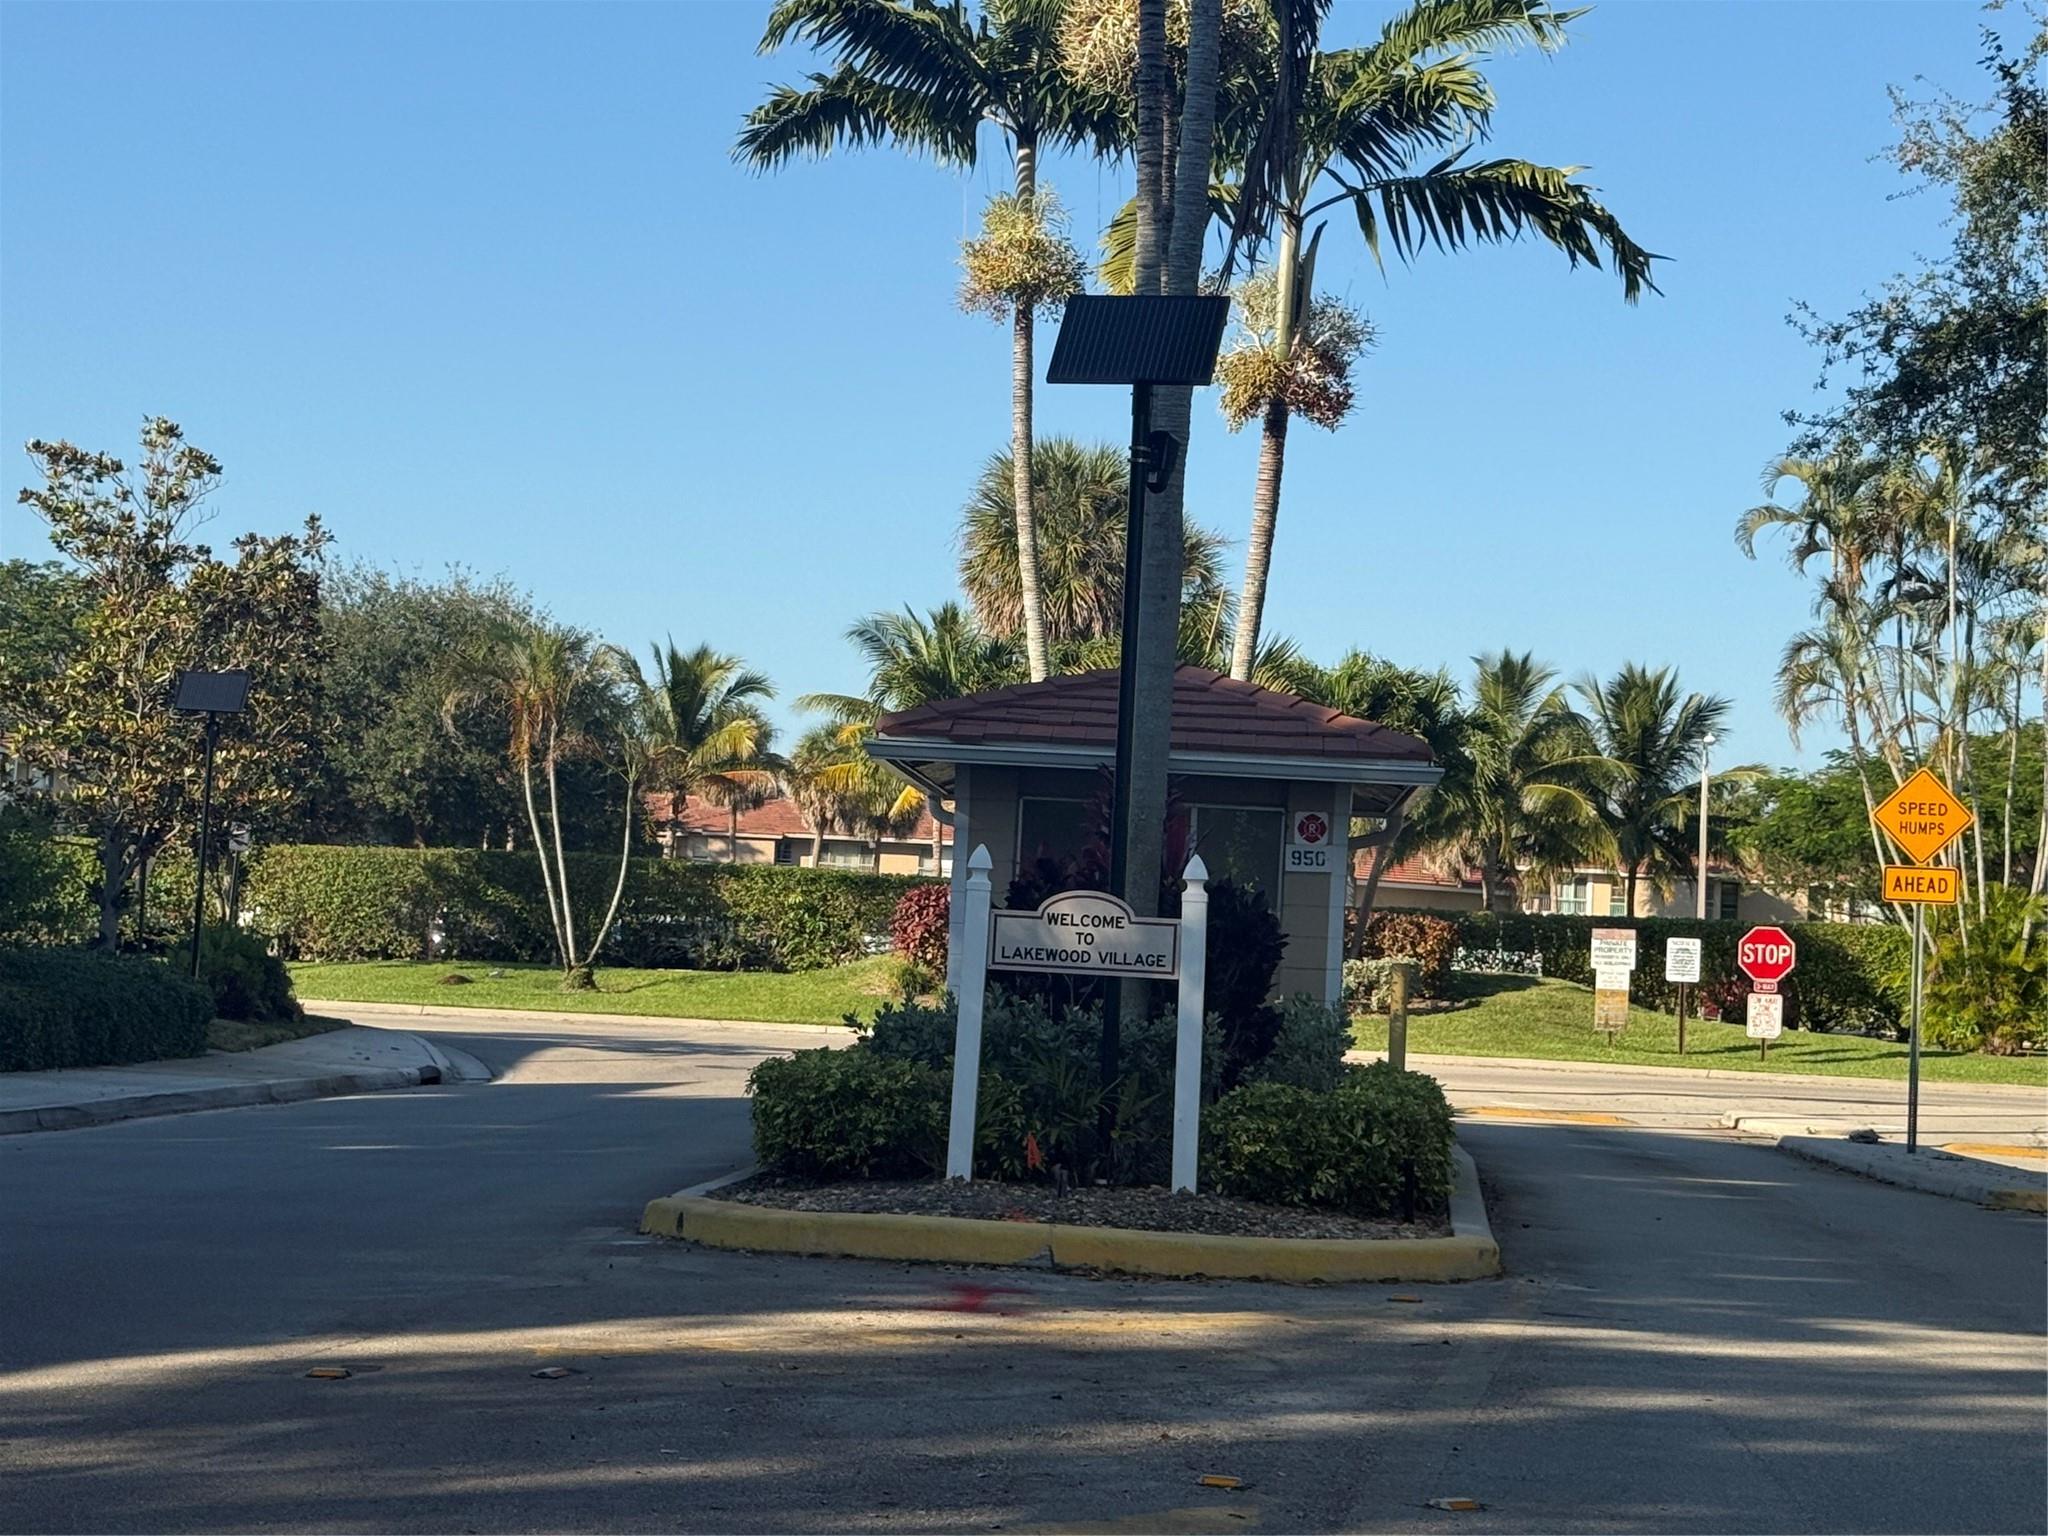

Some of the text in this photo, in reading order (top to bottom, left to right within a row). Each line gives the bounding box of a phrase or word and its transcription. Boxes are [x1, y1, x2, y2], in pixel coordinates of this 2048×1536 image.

[1898, 802, 1948, 817] SPEED
[1308, 823, 1317, 834] R
[1899, 822, 1945, 836] HUMPS
[1291, 850, 1326, 867] 950
[1892, 876, 1948, 894] AHEAD
[1046, 912, 1126, 929] WELCOME
[1075, 931, 1095, 946] TO
[1001, 946, 1167, 968] LAKEWOOD VILLAGE
[1593, 946, 1633, 954] PROPERTY
[1742, 943, 1791, 965] STOP
